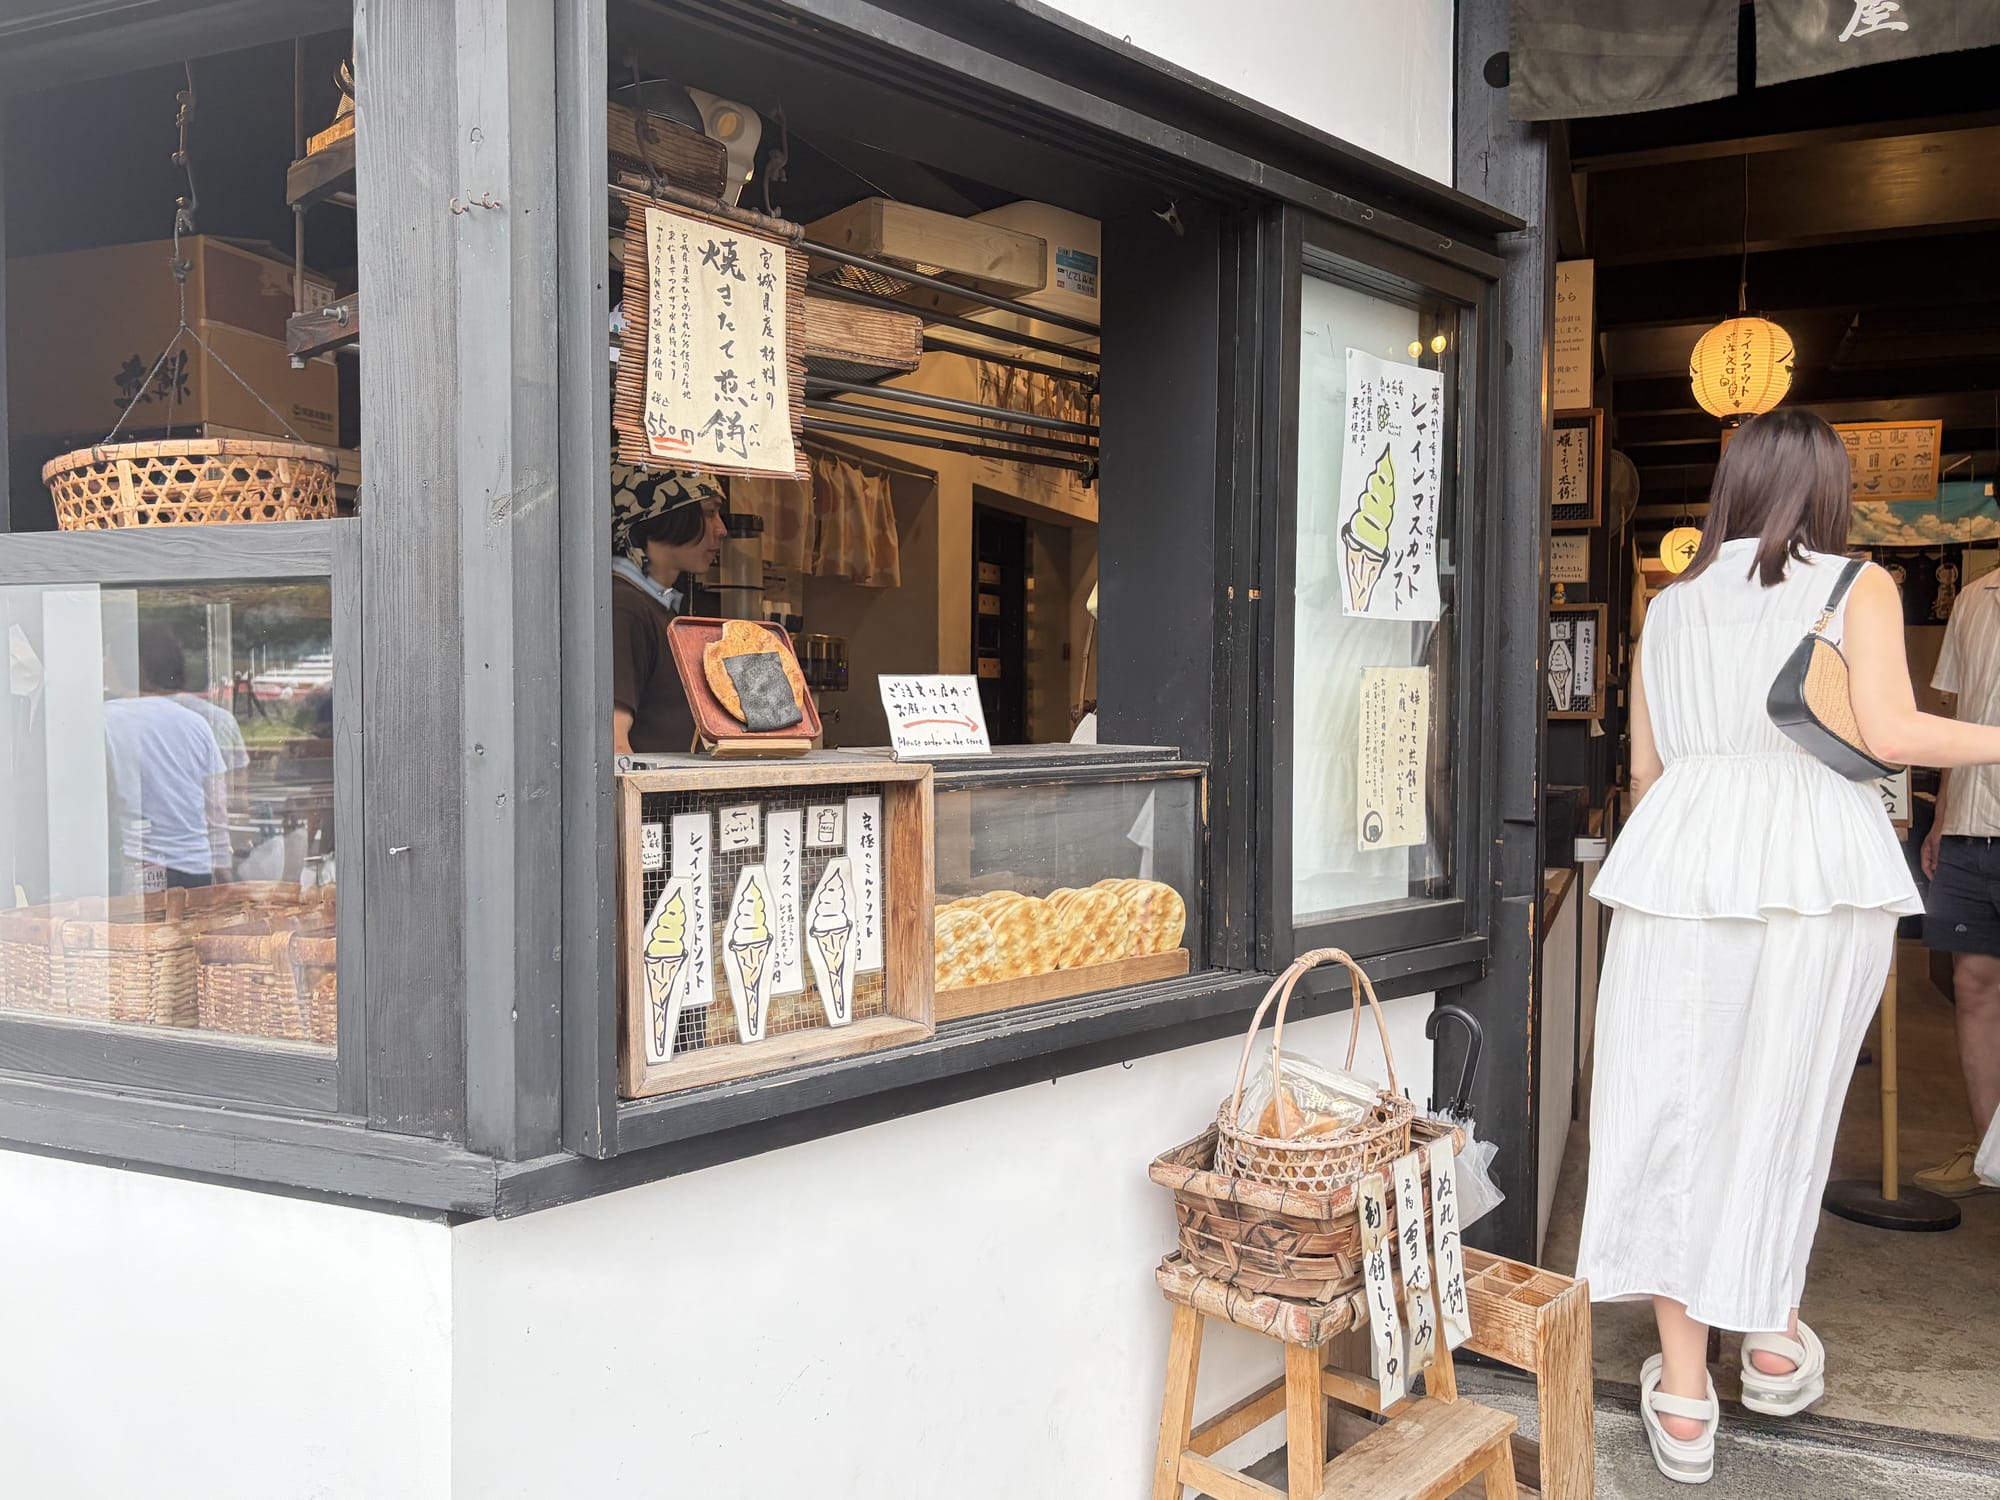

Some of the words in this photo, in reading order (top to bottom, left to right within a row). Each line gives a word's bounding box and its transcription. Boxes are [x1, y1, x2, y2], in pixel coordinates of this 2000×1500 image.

[1741, 329, 1755, 397] テイクアウト
[1406, 393, 1428, 599] シャインマスカット
[1393, 549, 1405, 612] ソフト
[897, 736, 921, 748] Please
[924, 733, 942, 747] order
